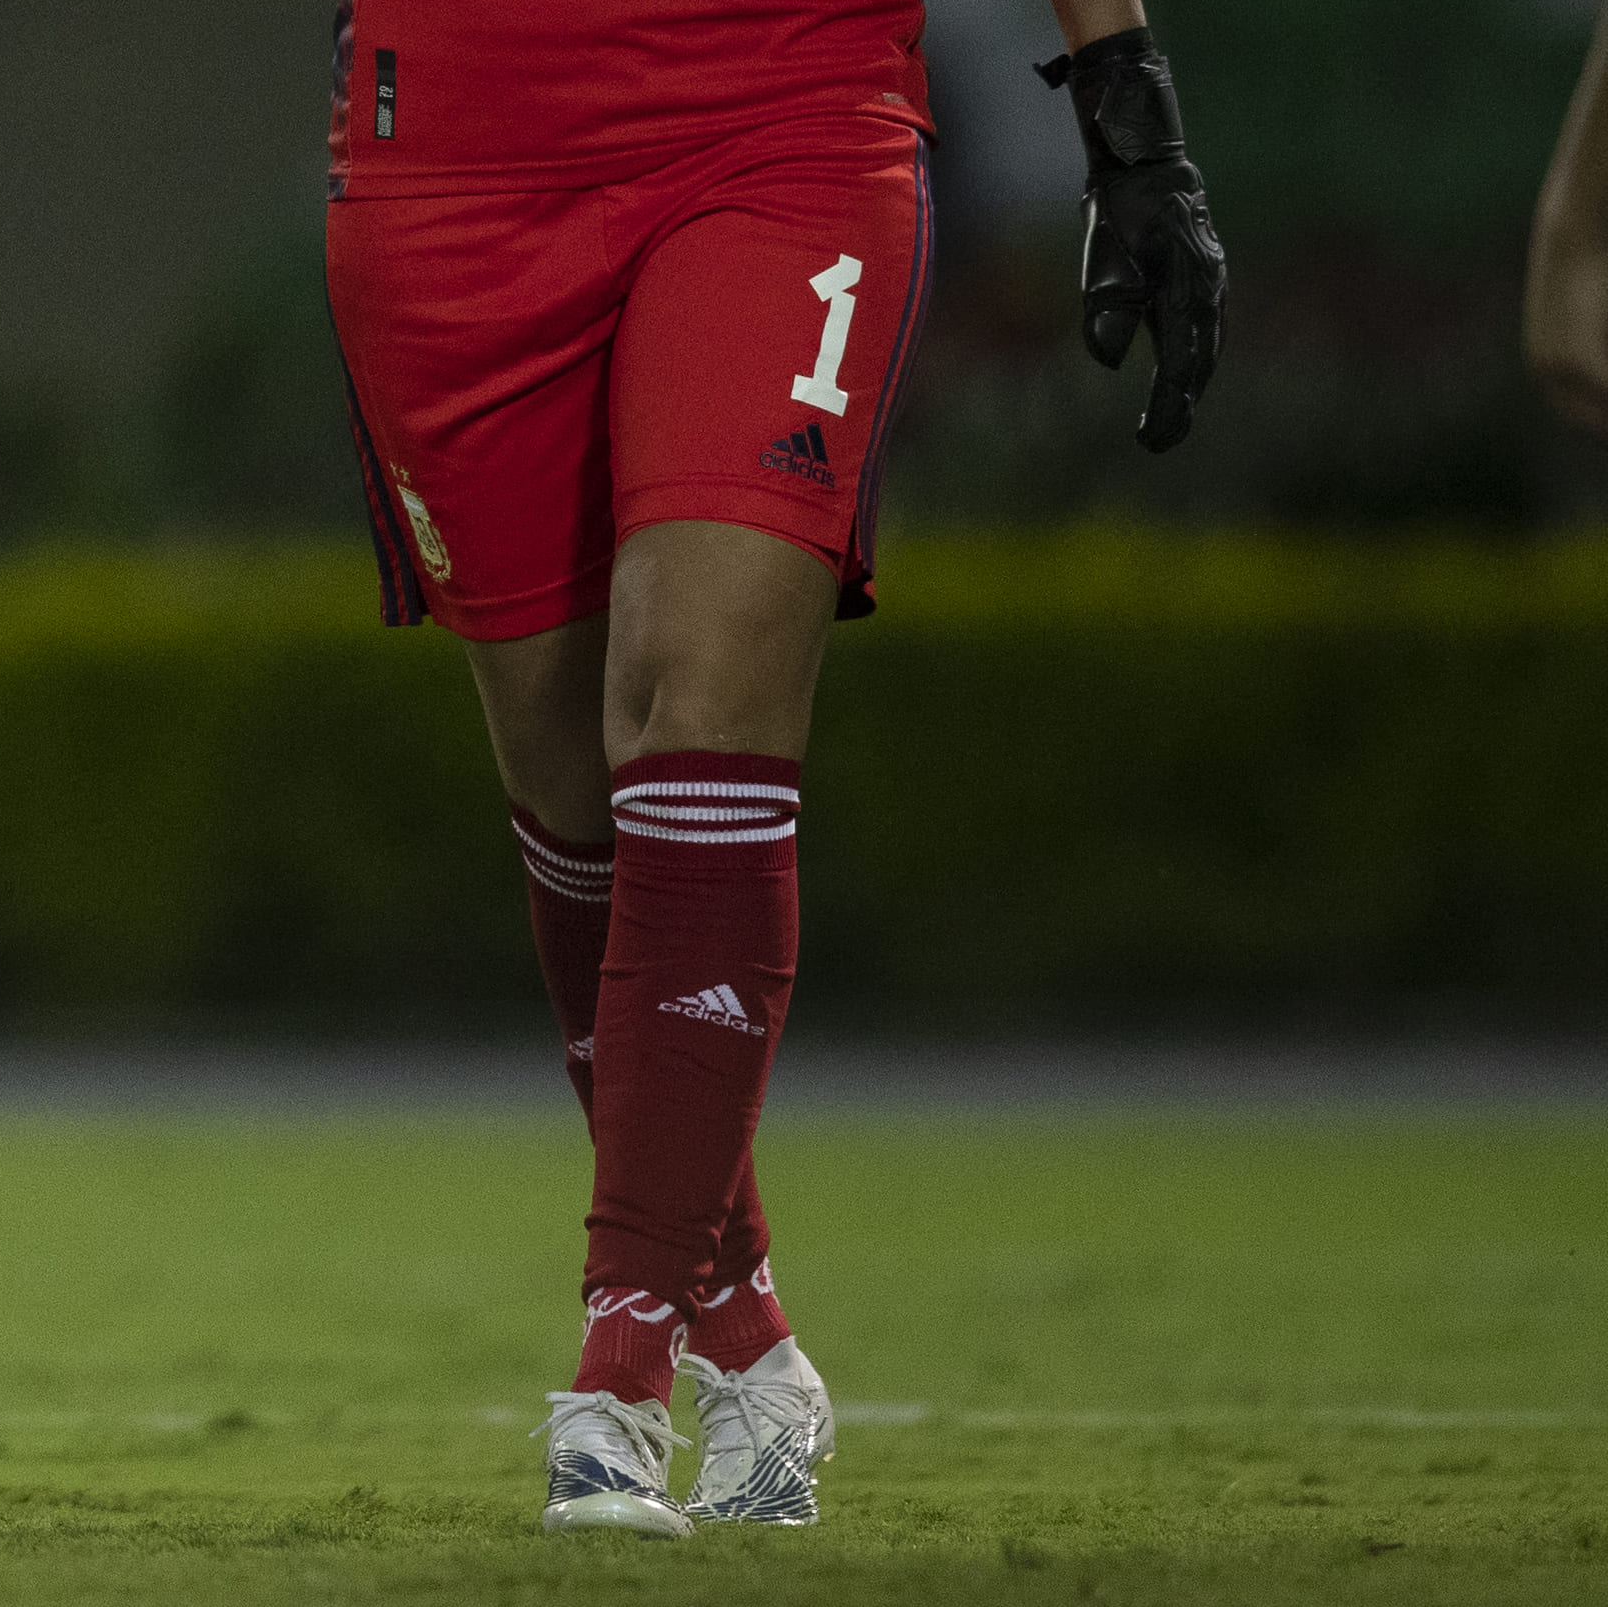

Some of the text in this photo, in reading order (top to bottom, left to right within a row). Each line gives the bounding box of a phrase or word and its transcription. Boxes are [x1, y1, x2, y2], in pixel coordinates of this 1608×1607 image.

[791, 253, 862, 417] 1
[759, 451, 835, 488] adidas
[657, 1002, 765, 1036] adidas
